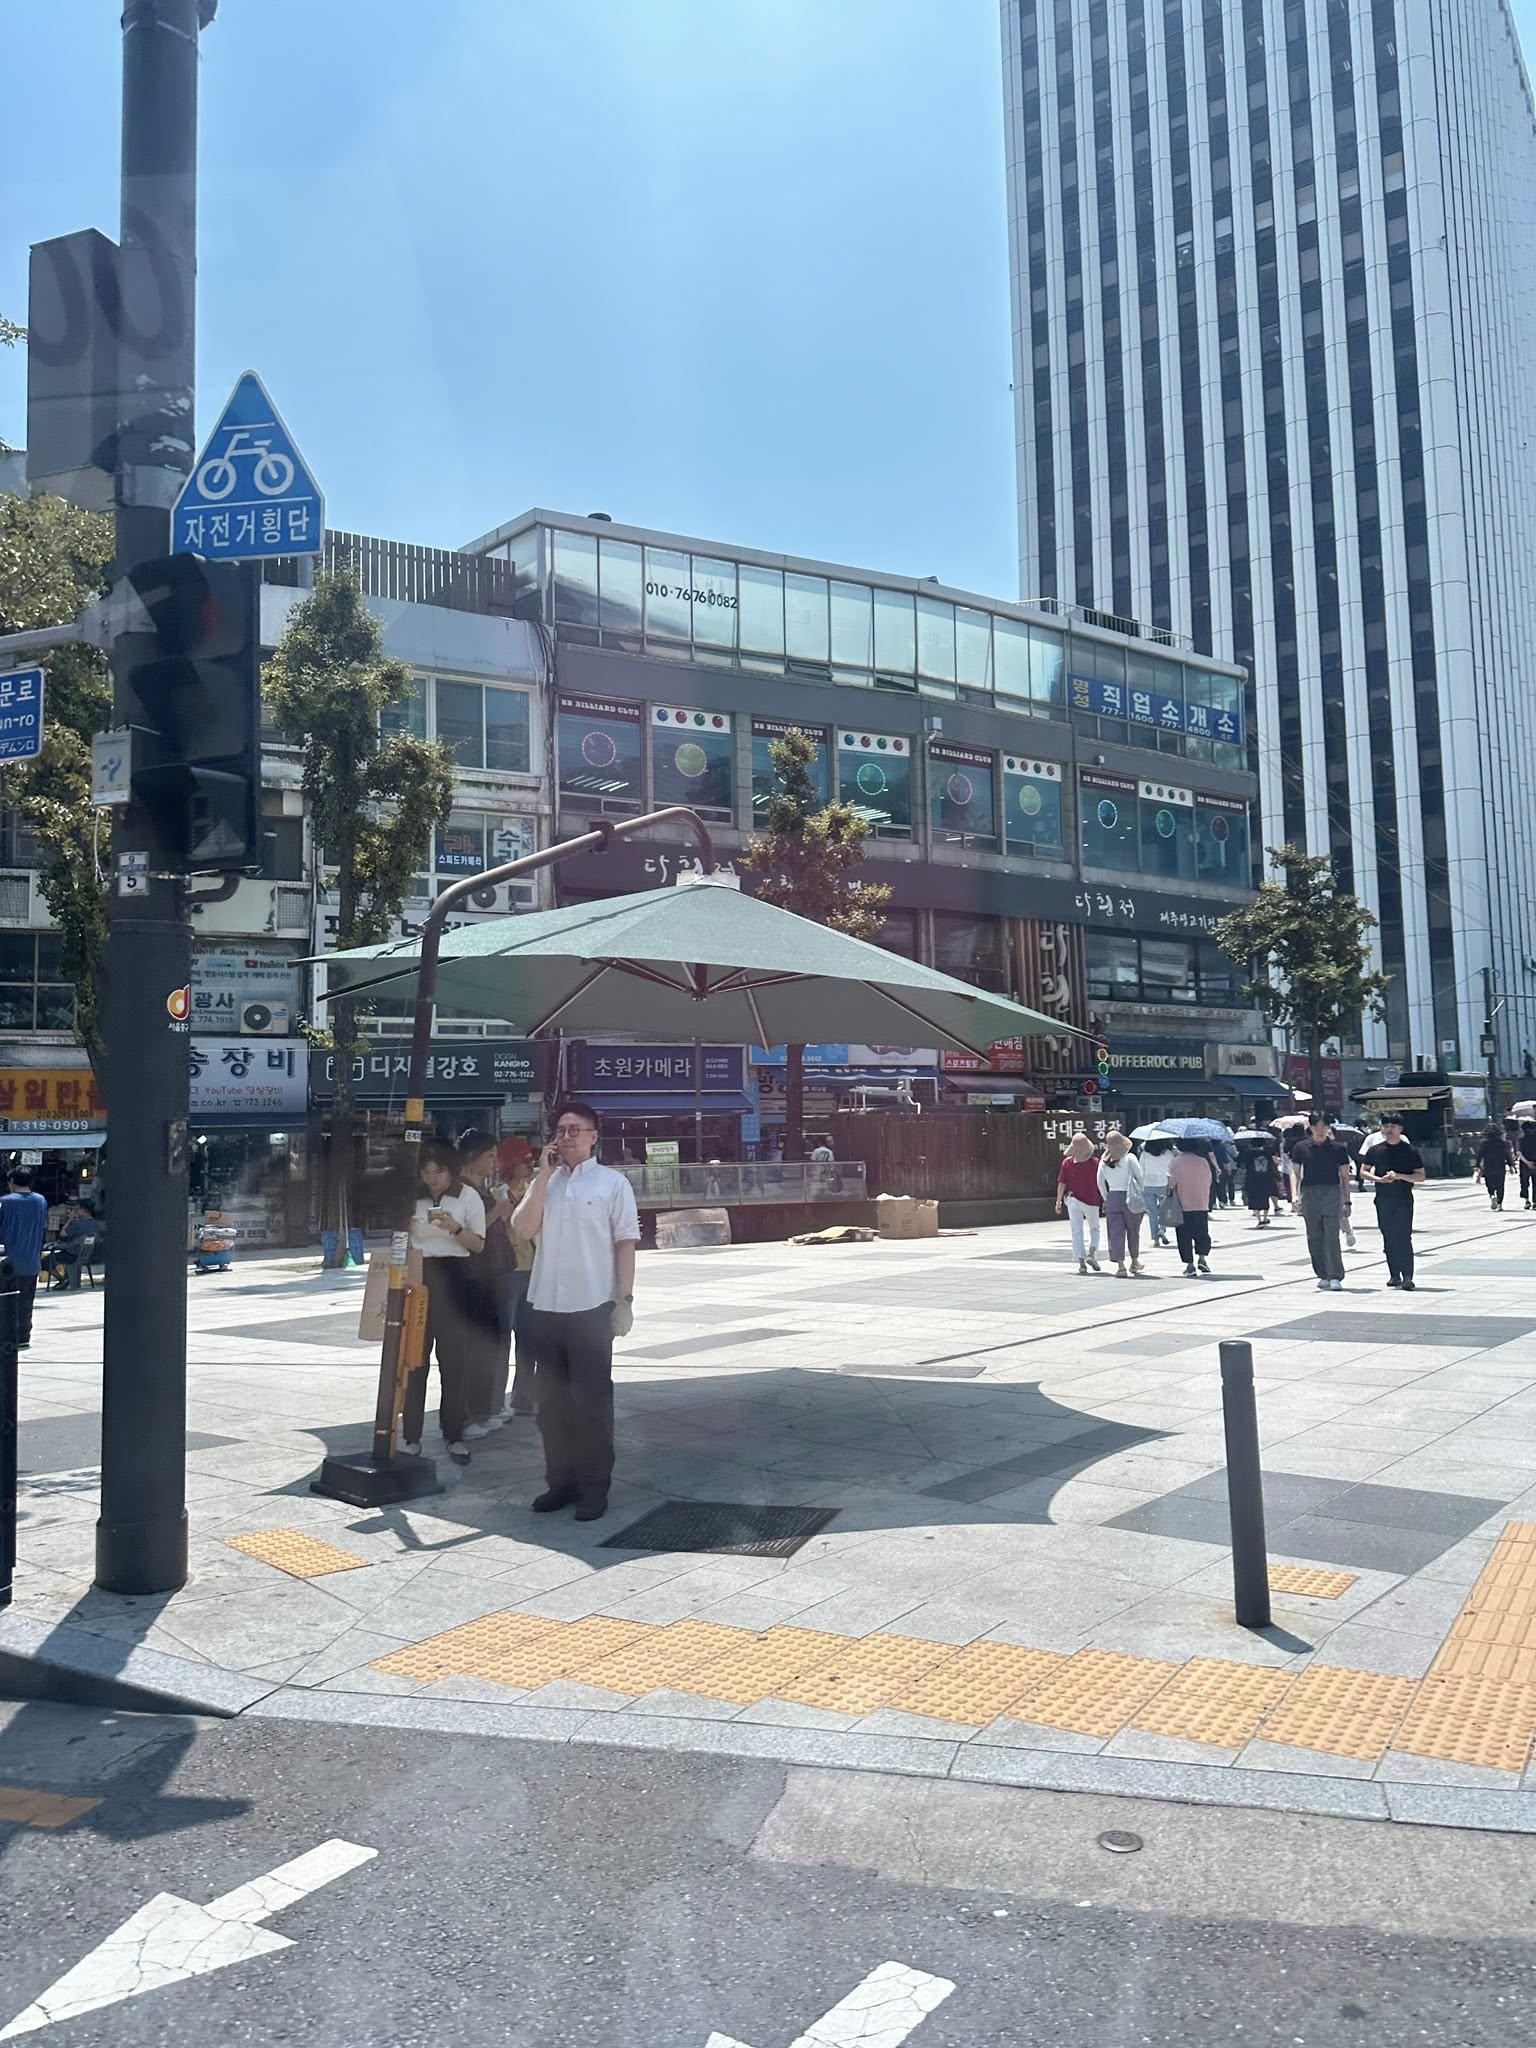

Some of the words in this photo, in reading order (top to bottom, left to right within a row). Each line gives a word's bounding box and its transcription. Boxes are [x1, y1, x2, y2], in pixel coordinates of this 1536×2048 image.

[184, 506, 310, 549] 자전거횡단
[1102, 684, 1235, 734] 직업소개소
[0, 714, 35, 730] n-ro
[766, 723, 803, 734] BILLIAD
[438, 854, 482, 867] 스피드카메라
[594, 1057, 692, 1078] 초원카메라
[1108, 1055, 1177, 1069] OFFEEROCK
[1179, 1057, 1203, 1069] PUB
